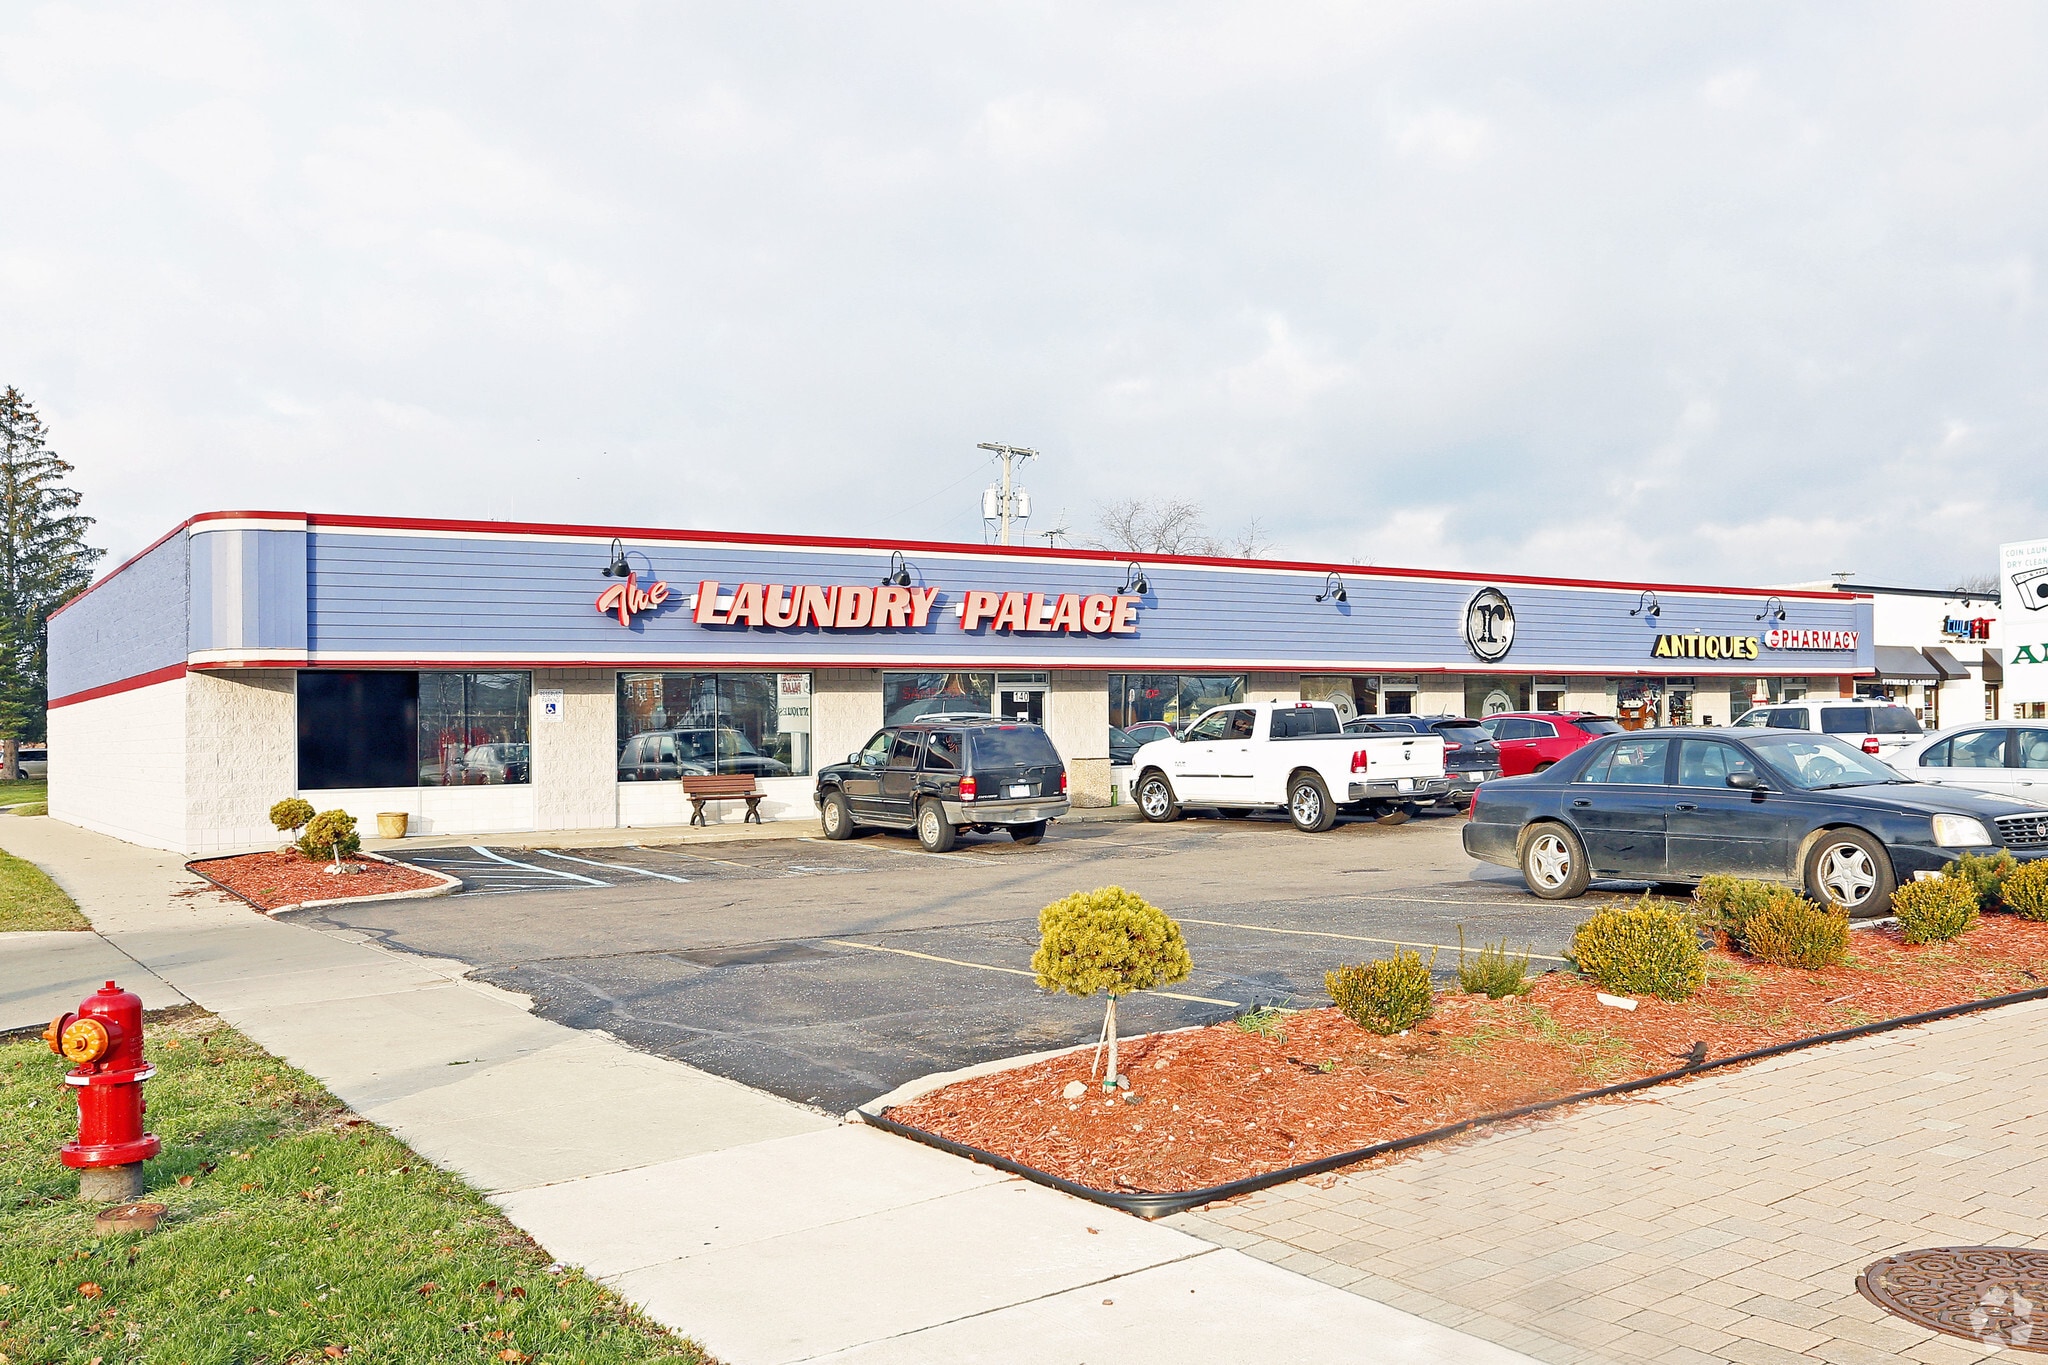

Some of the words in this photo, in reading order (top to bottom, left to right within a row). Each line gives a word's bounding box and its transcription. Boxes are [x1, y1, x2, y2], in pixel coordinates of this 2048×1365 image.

[2005, 549, 2023, 557] COIN
[2007, 561, 2021, 569] DRY
[595, 572, 669, 627] The
[693, 580, 940, 628] LAUNDRY
[960, 591, 1141, 634] PALACE
[1782, 630, 1859, 649] PHARMACY
[1652, 634, 1759, 660] ANTIQUES
[1014, 692, 1029, 702] 140
